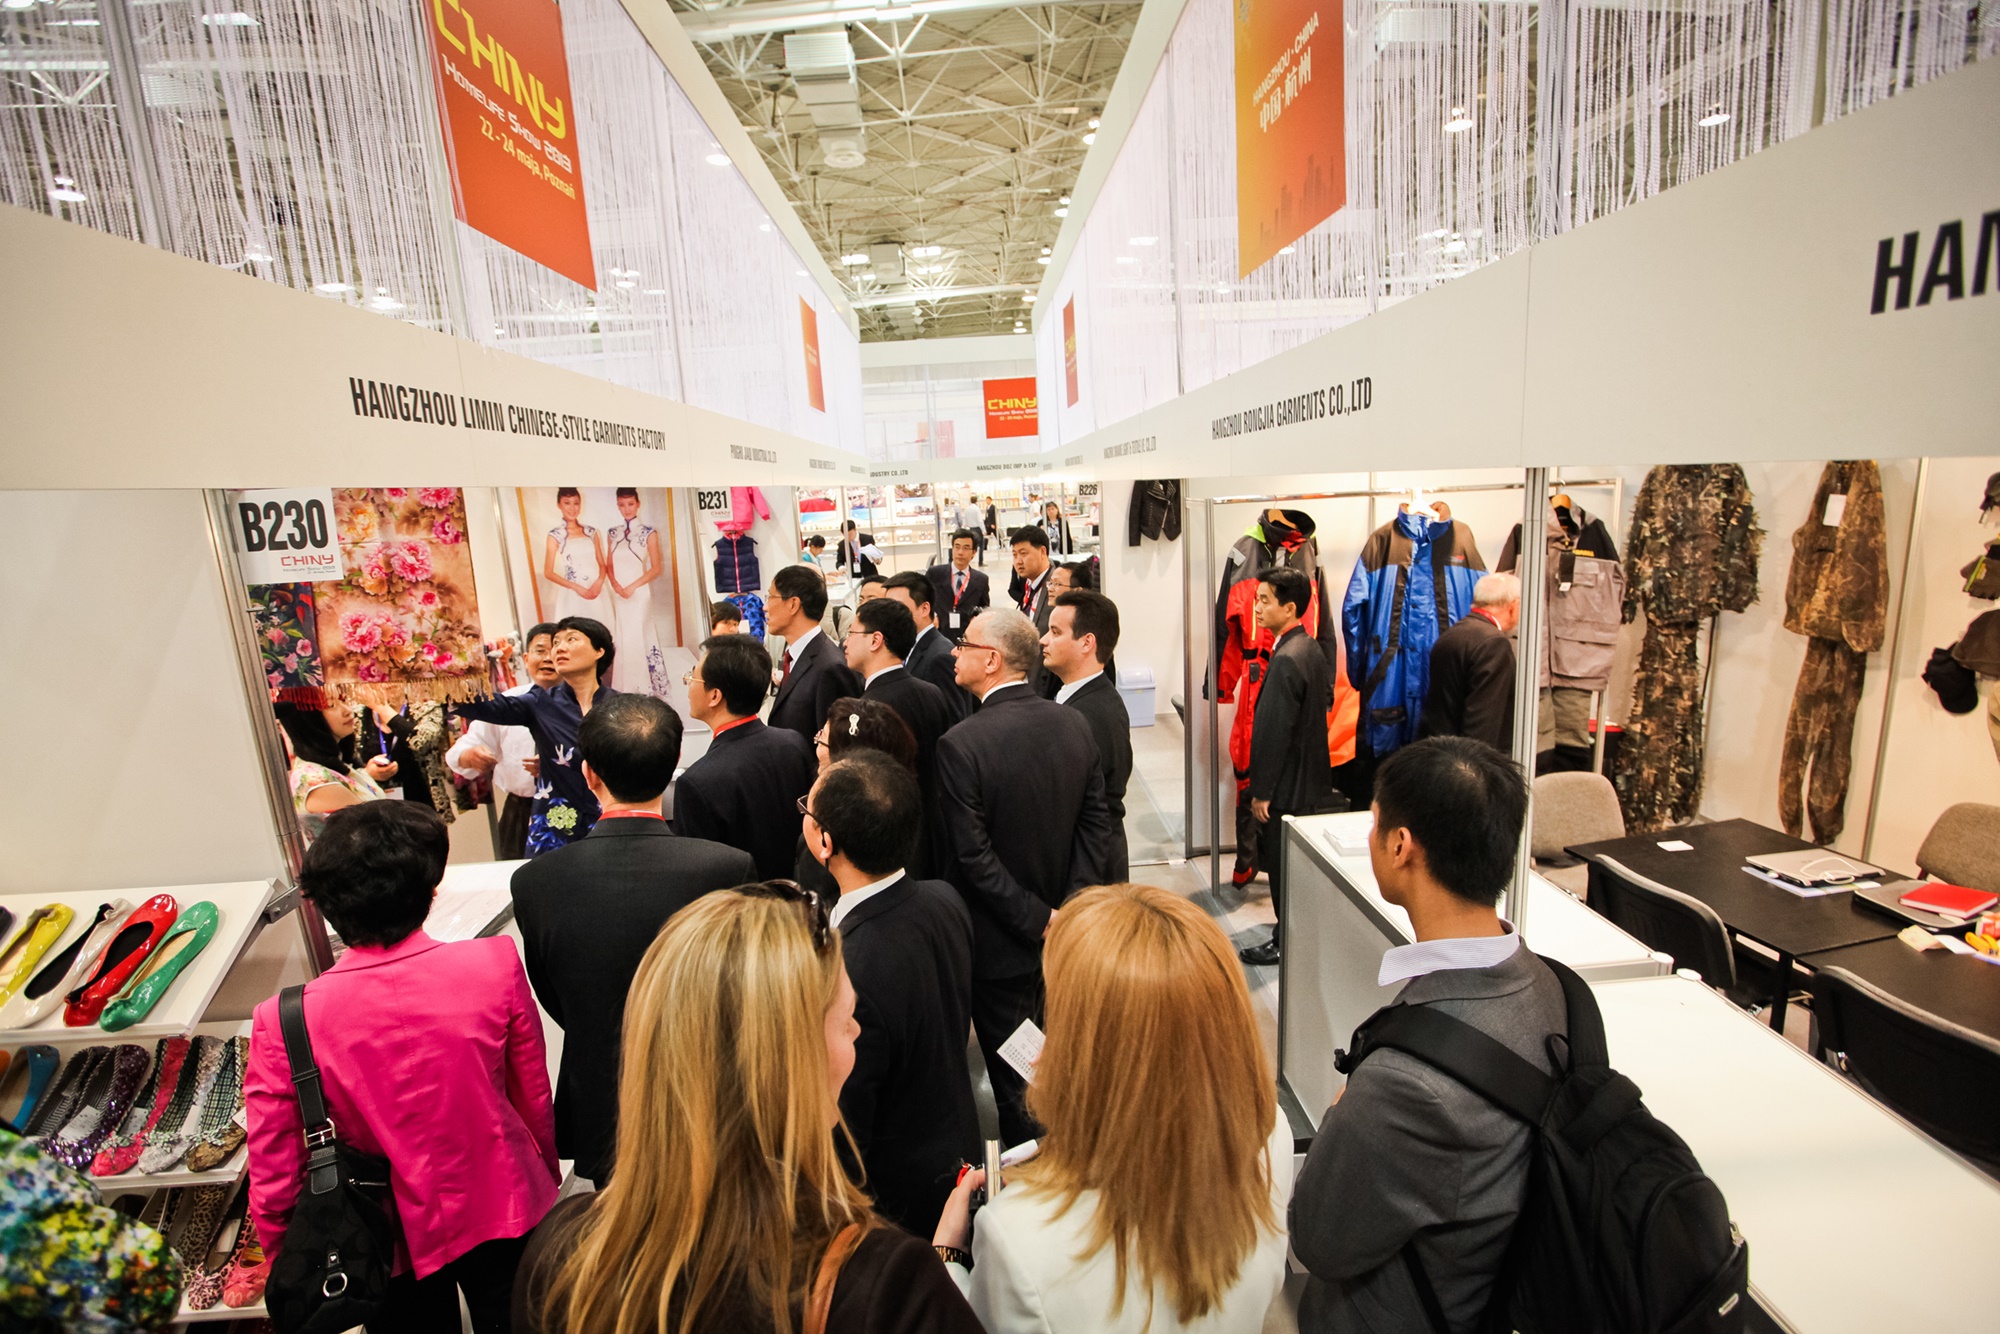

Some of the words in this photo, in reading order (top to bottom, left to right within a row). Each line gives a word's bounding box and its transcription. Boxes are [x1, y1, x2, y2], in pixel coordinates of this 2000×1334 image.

[434, 0, 566, 140] CHINY
[479, 115, 495, 141] 22
[501, 132, 516, 157] 24
[349, 377, 458, 428] HANGZHOU
[460, 396, 506, 433] LIMIN
[508, 404, 592, 442] CHINESE-STYLE
[593, 419, 637, 448] GARMENTS
[638, 429, 667, 451] FACTORY
[987, 397, 1037, 410] CHINY
[1211, 412, 1242, 440] HANGZHOU
[1276, 388, 1326, 427] GARMENTS
[1328, 376, 1373, 416] CO.,LTD
[698, 490, 728, 510] B231
[1079, 484, 1098, 496] B226
[238, 499, 329, 552] B230
[281, 554, 335, 567] CHINY
